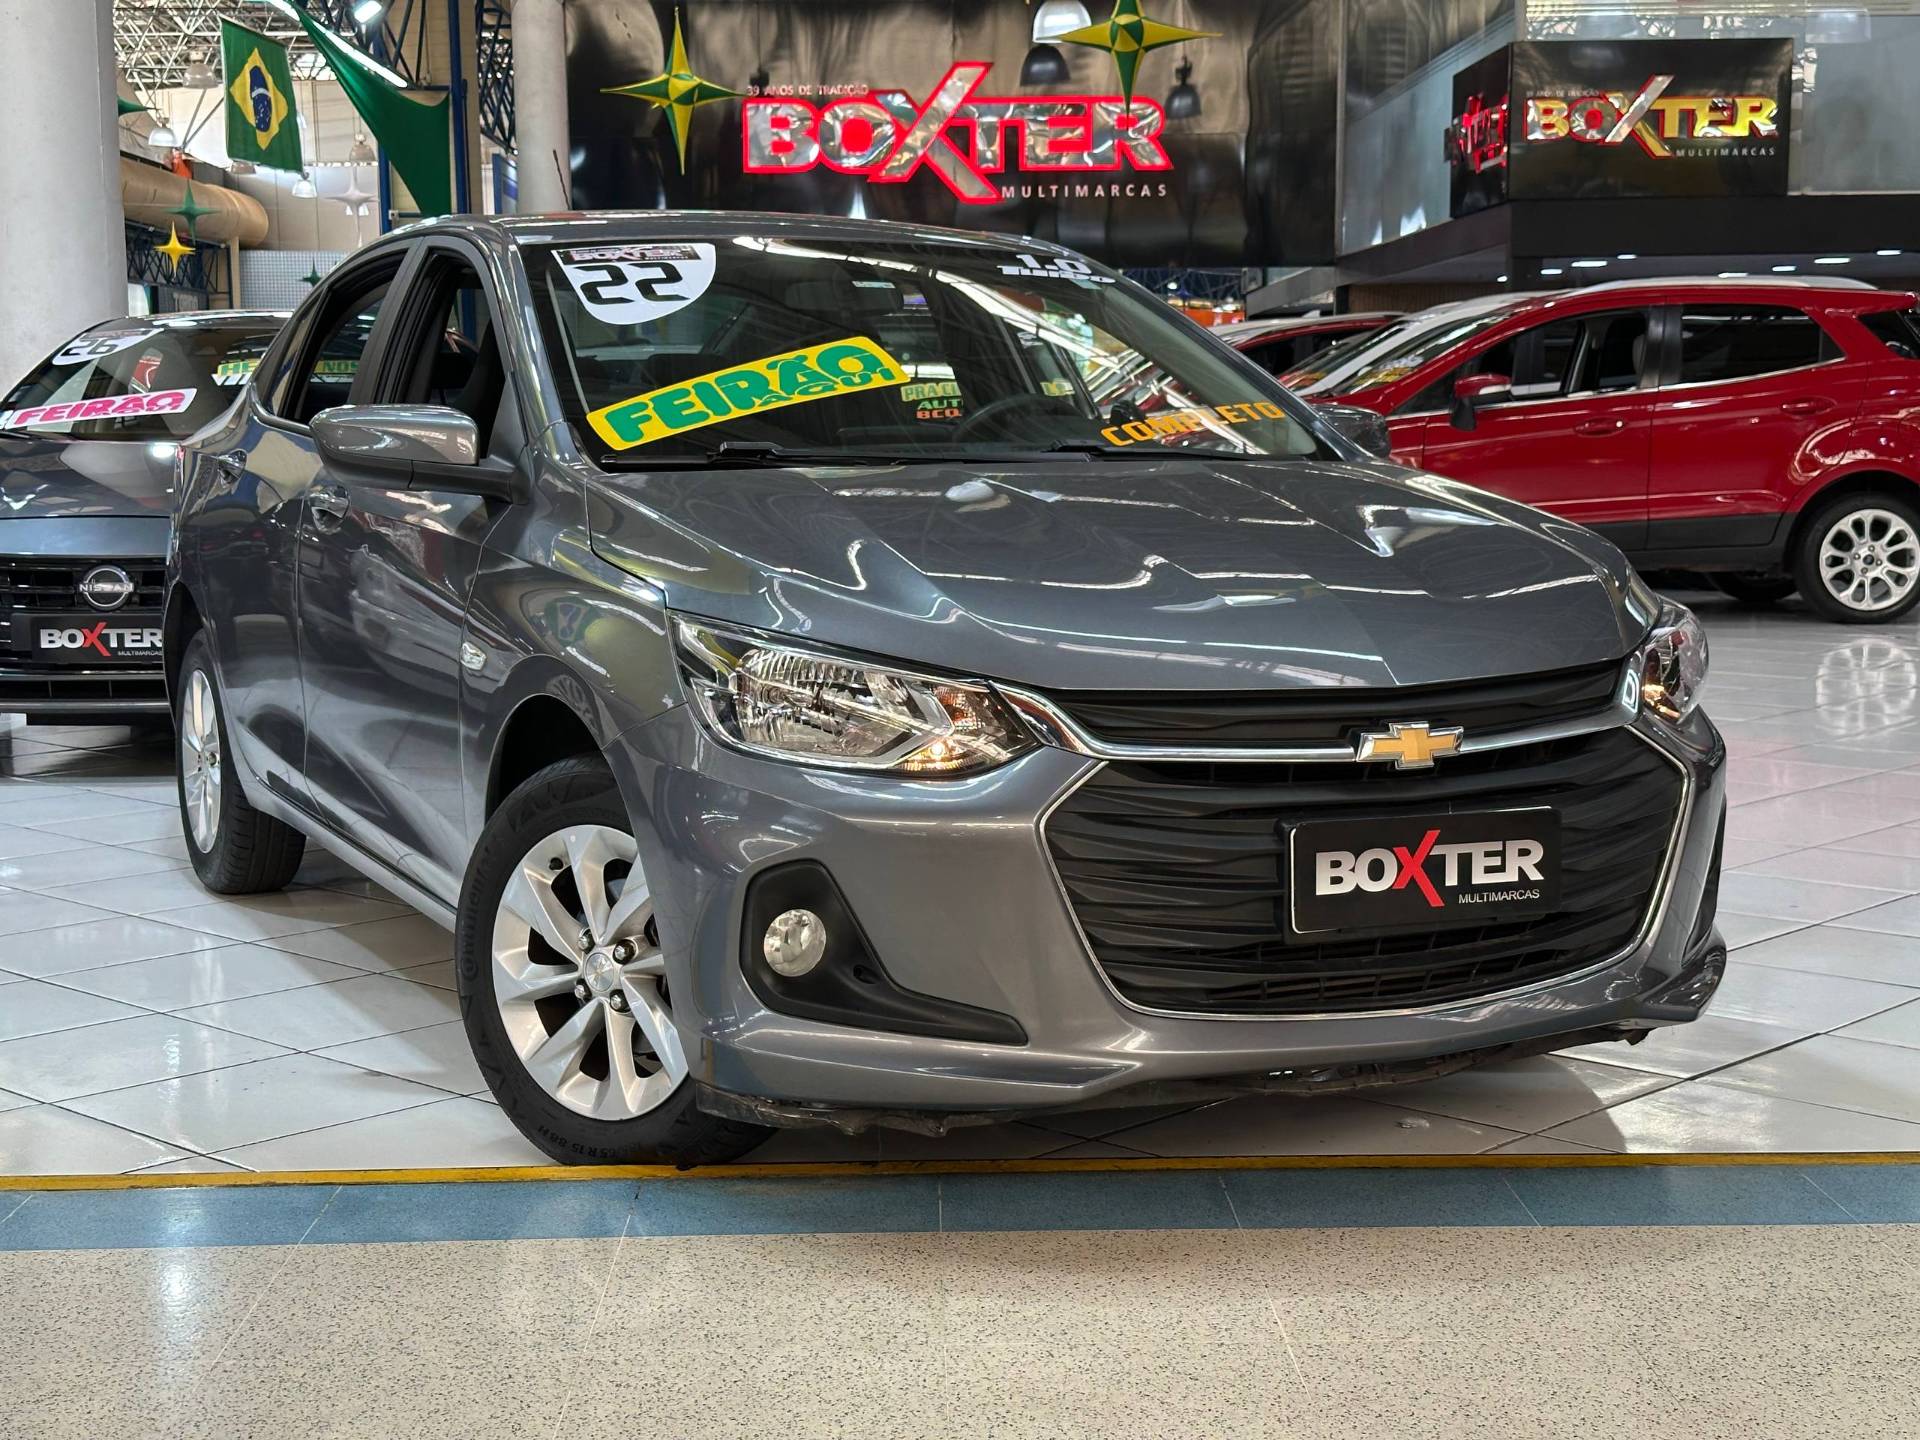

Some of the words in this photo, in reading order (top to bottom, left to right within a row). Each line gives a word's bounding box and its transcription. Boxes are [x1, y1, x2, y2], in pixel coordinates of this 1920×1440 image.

[764, 85, 794, 96] ANOS
[799, 85, 812, 96] DE
[742, 61, 1174, 205] BOXTER
[1524, 74, 1780, 159] BOXTER
[1675, 148, 1776, 158] MULTIMARCAS
[1001, 184, 1167, 199] MULTIMARCAS
[573, 262, 691, 305] 22
[60, 338, 119, 357] 26
[604, 344, 886, 443] FEIRÃO
[1101, 402, 1286, 447] COMPLETO
[79, 582, 134, 592] NISSAN
[40, 621, 163, 656] BOXTER
[1315, 829, 1545, 907] BOXTER
[1458, 889, 1541, 904] MULTIMARCAS
